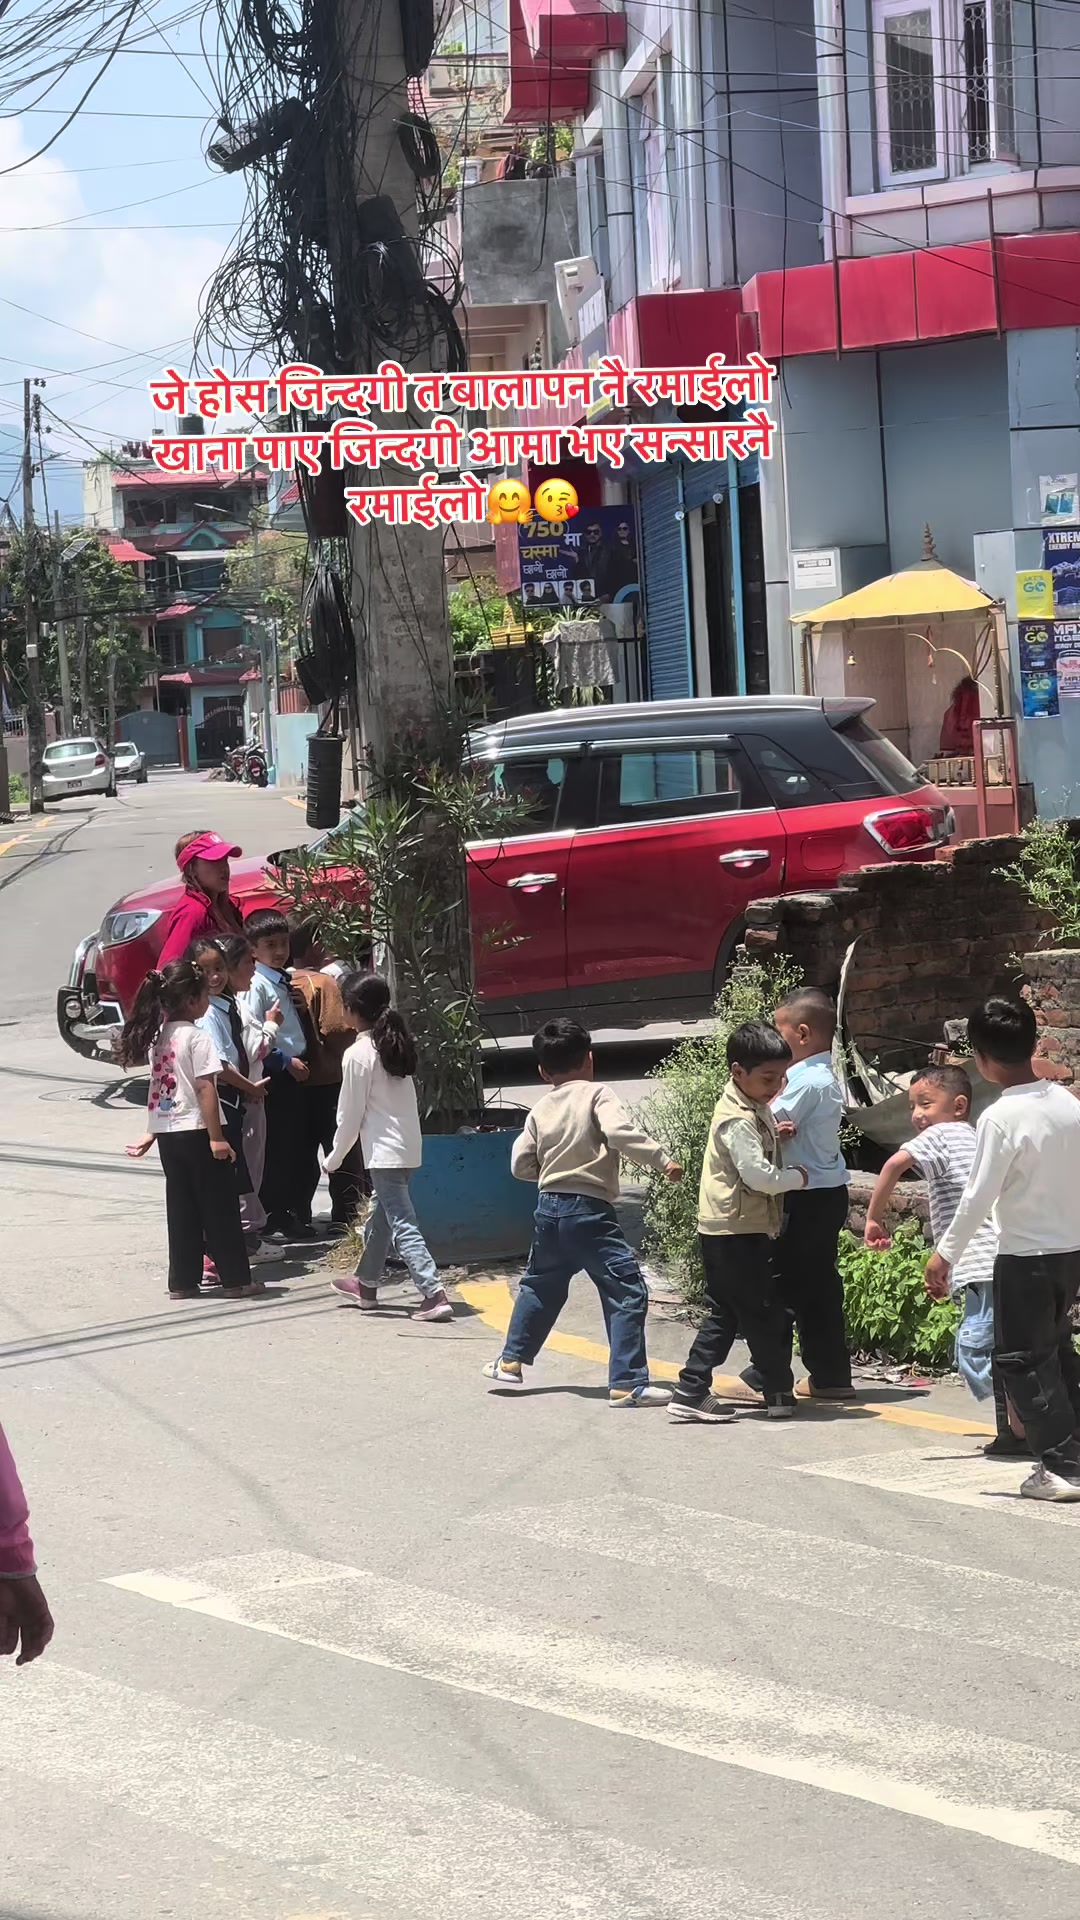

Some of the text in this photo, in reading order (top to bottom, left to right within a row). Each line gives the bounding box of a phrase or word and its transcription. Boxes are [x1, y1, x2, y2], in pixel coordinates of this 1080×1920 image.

[523, 520, 582, 547] 750 मा
[1023, 582, 1046, 592] GO
[1024, 632, 1048, 643] GO
[1028, 679, 1051, 690] GO
